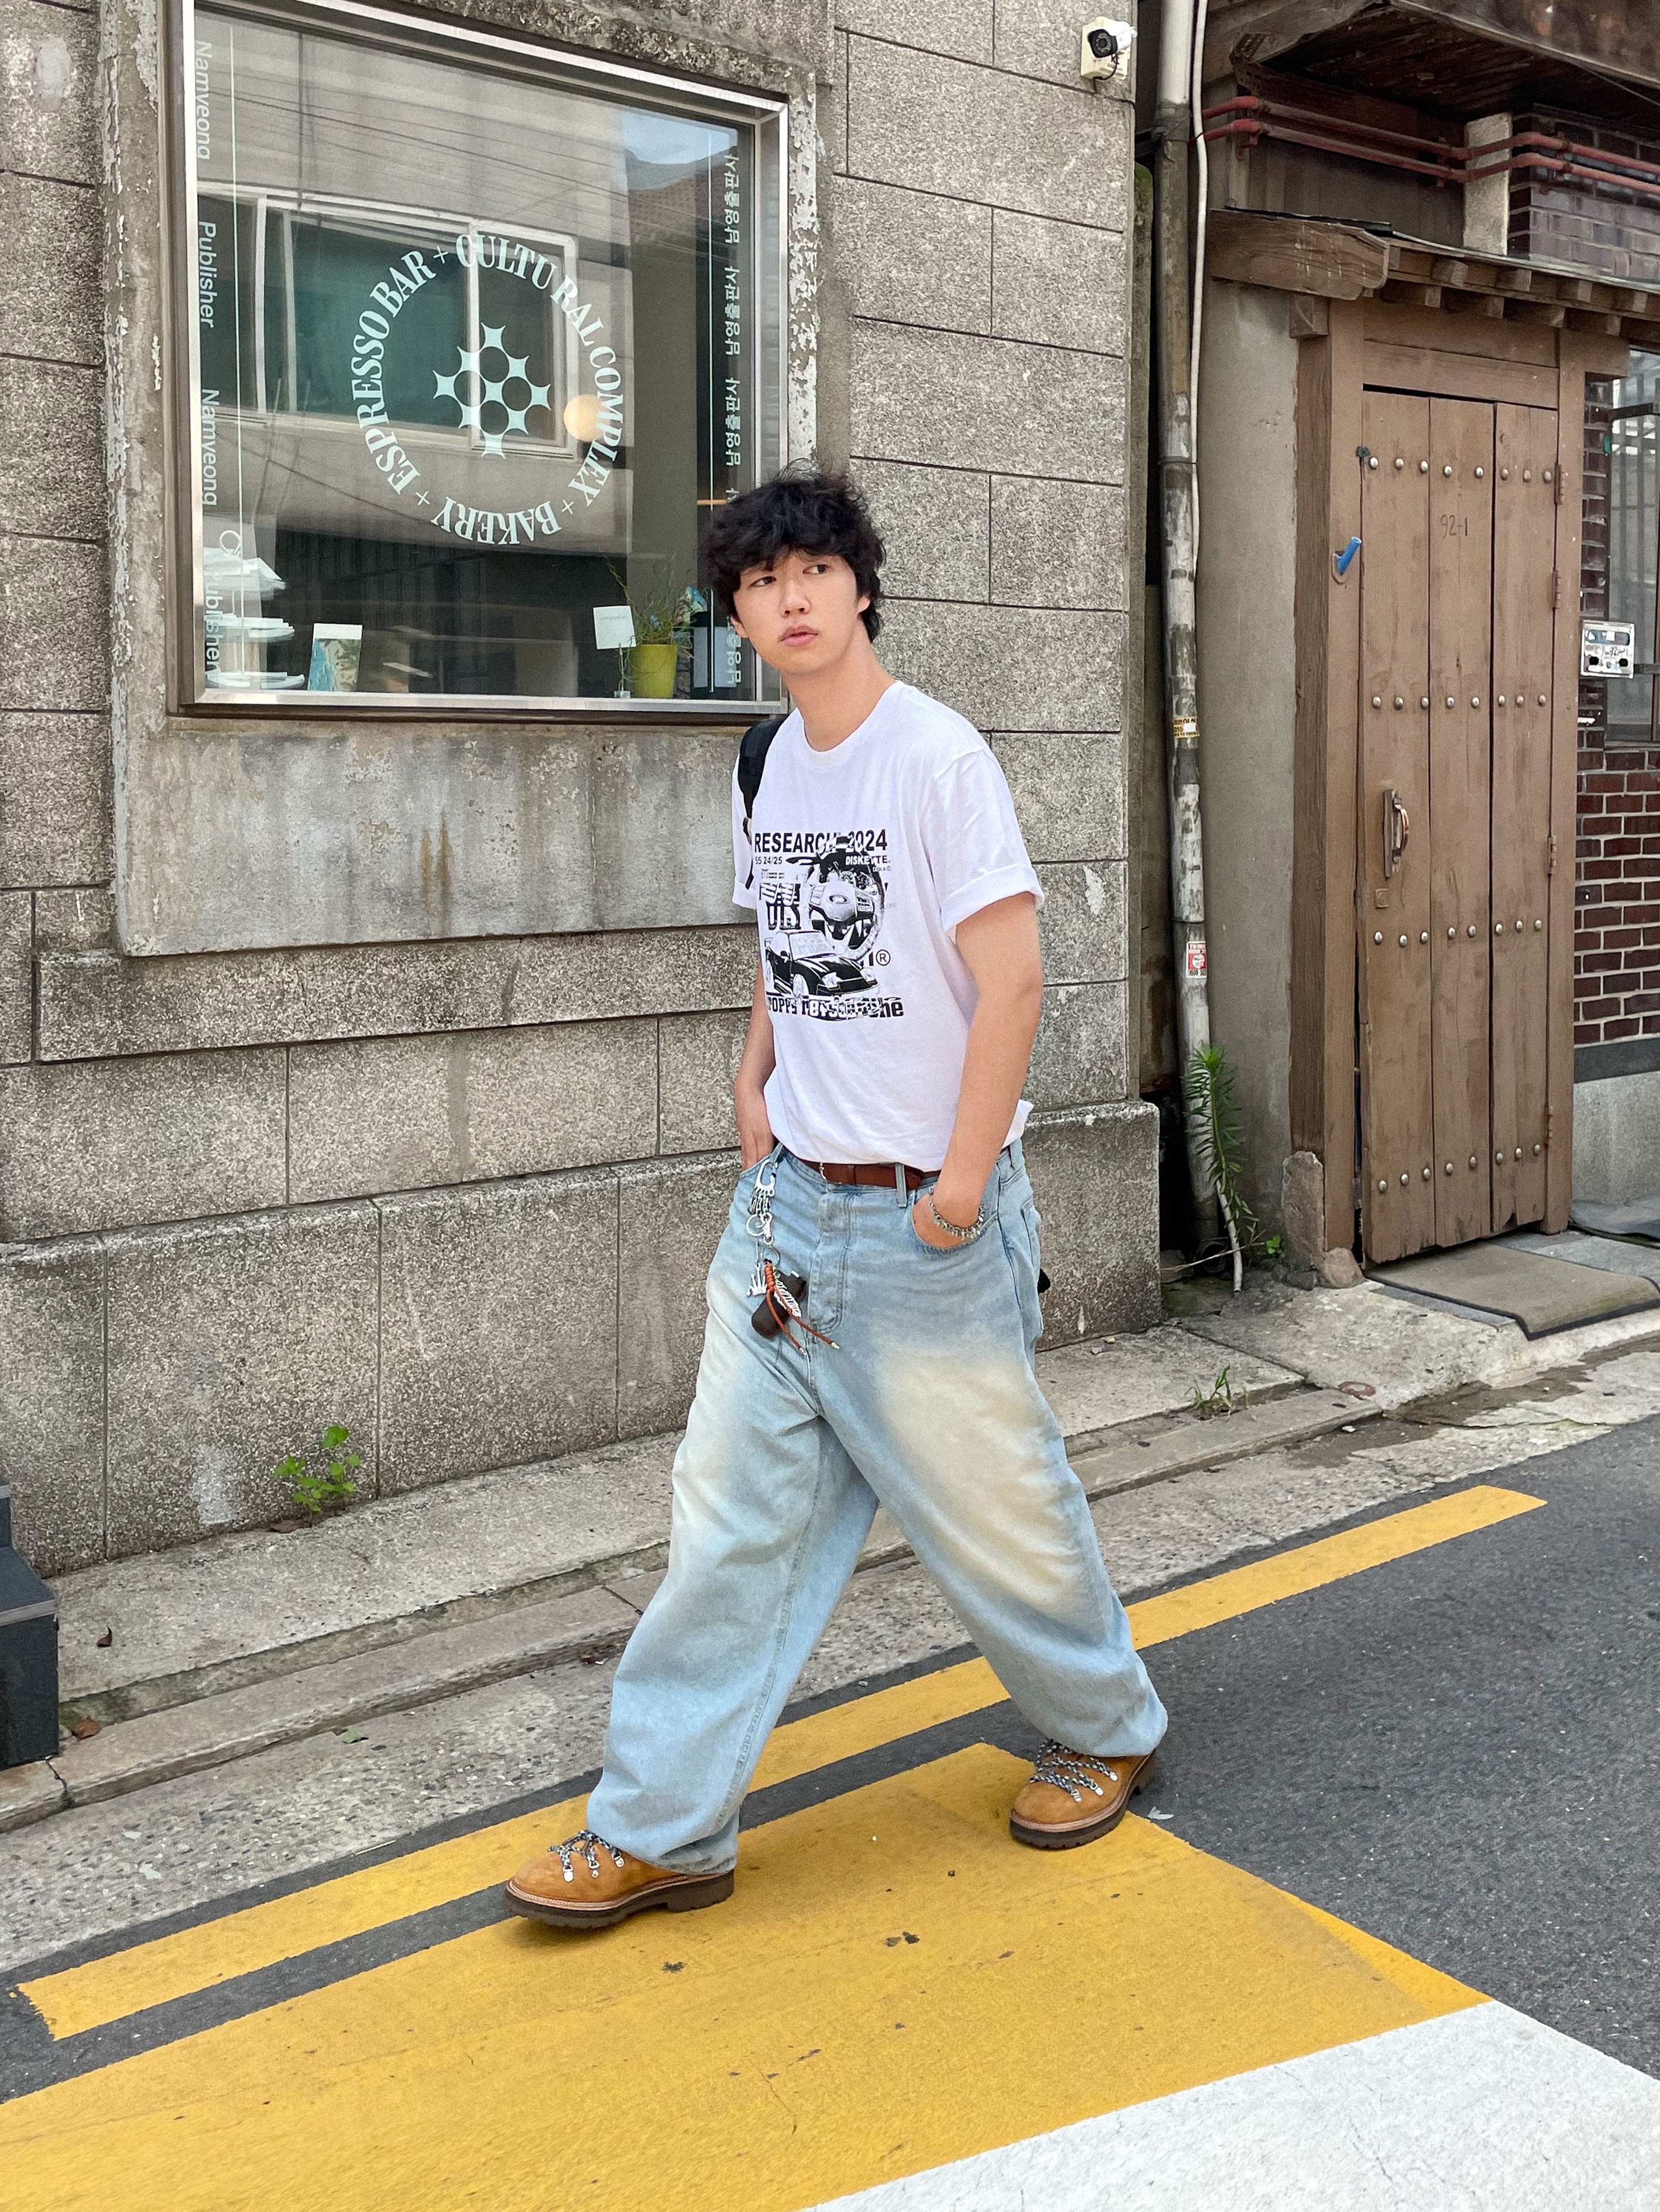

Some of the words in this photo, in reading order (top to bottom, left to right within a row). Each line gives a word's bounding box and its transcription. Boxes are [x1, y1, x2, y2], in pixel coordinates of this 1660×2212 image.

[723, 153, 740, 243] 남영출판사
[198, 221, 217, 328] Publisher
[369, 250, 437, 318] BAR
[455, 233, 604, 347] CULTURAL
[724, 265, 740, 355] 남영출판사
[351, 310, 420, 495] ESPRESSO
[567, 345, 624, 506] COMPLEX
[725, 376, 741, 466] 남영출판사
[430, 496, 561, 545] BAKERY
[1440, 514, 1468, 539] 92-1
[763, 856, 783, 864] 24/25
[845, 829, 888, 853] 2024
